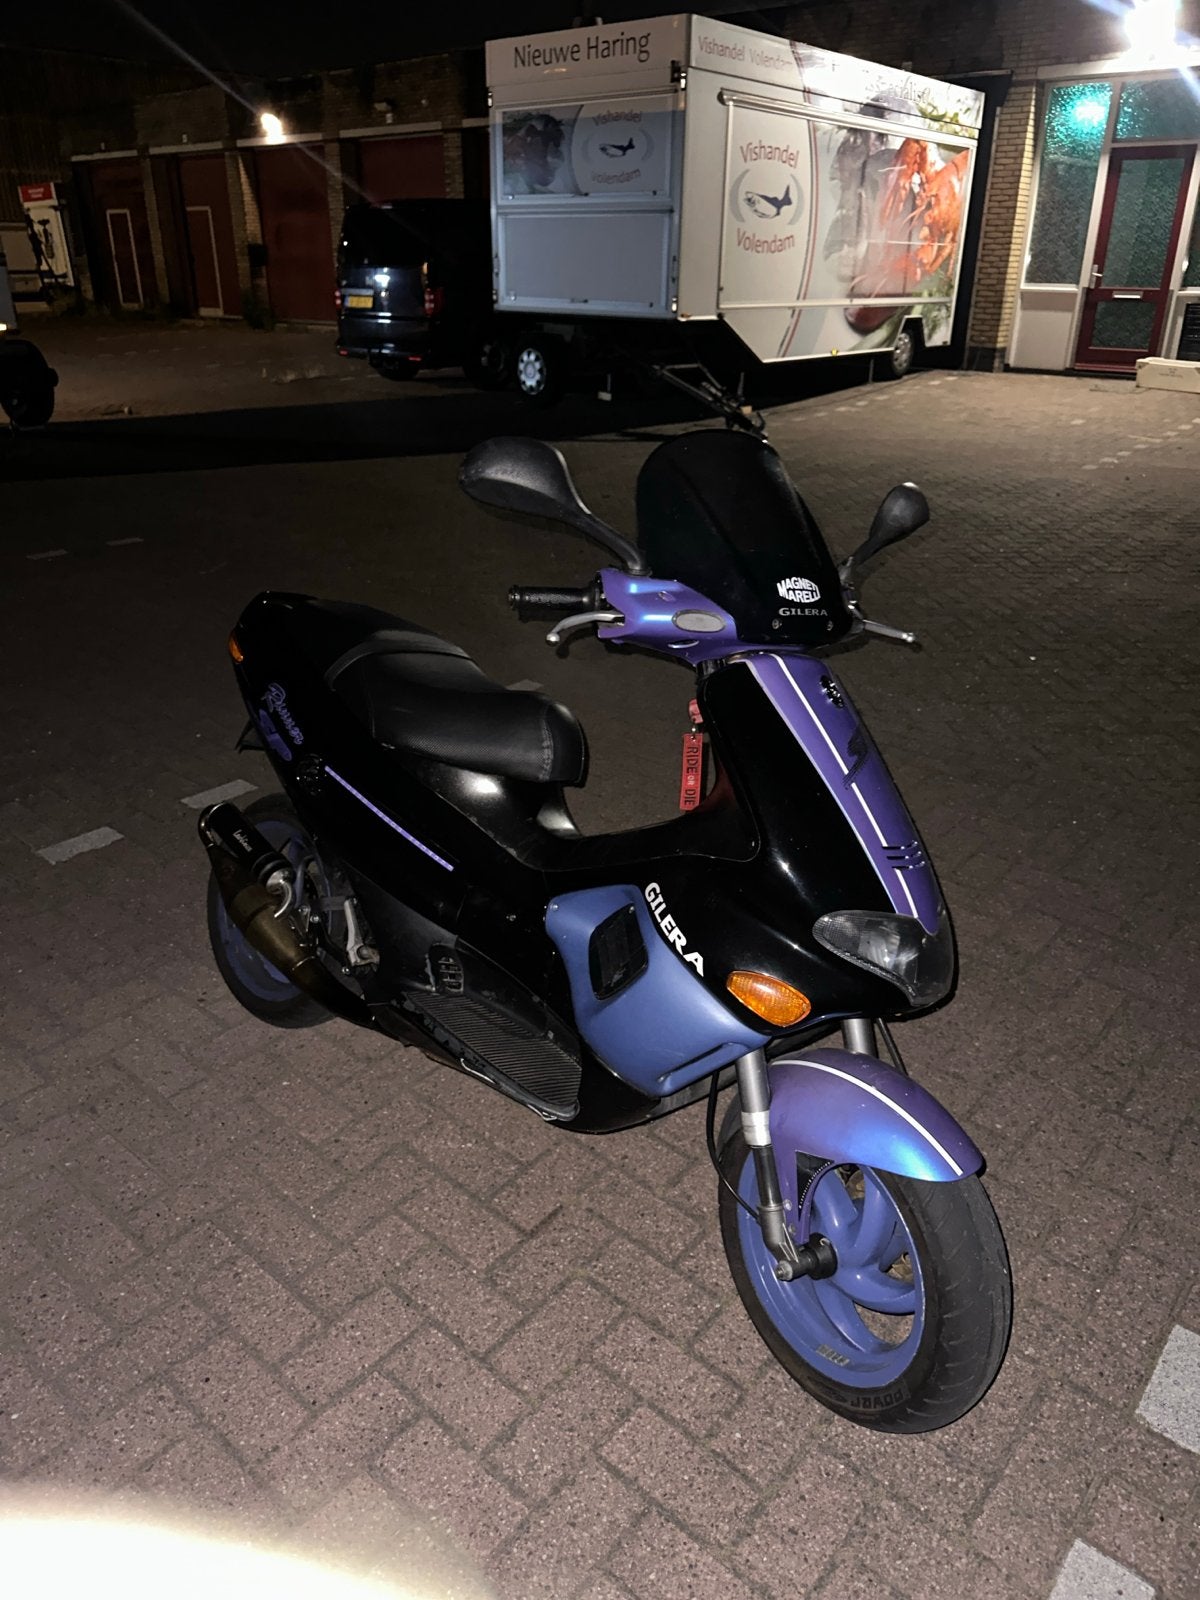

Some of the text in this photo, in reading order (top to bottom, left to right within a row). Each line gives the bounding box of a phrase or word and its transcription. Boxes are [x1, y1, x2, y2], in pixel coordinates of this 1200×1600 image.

[513, 31, 651, 68] Nieuwe Haring
[698, 36, 745, 61] Vishandel
[740, 139, 800, 169] Vishandel
[736, 228, 796, 254] Volendam
[778, 607, 828, 616] GILERA
[261, 682, 304, 745] Runner
[686, 746, 699, 773] RIDE
[684, 788, 696, 805] DIE
[644, 882, 704, 977] GILERA
